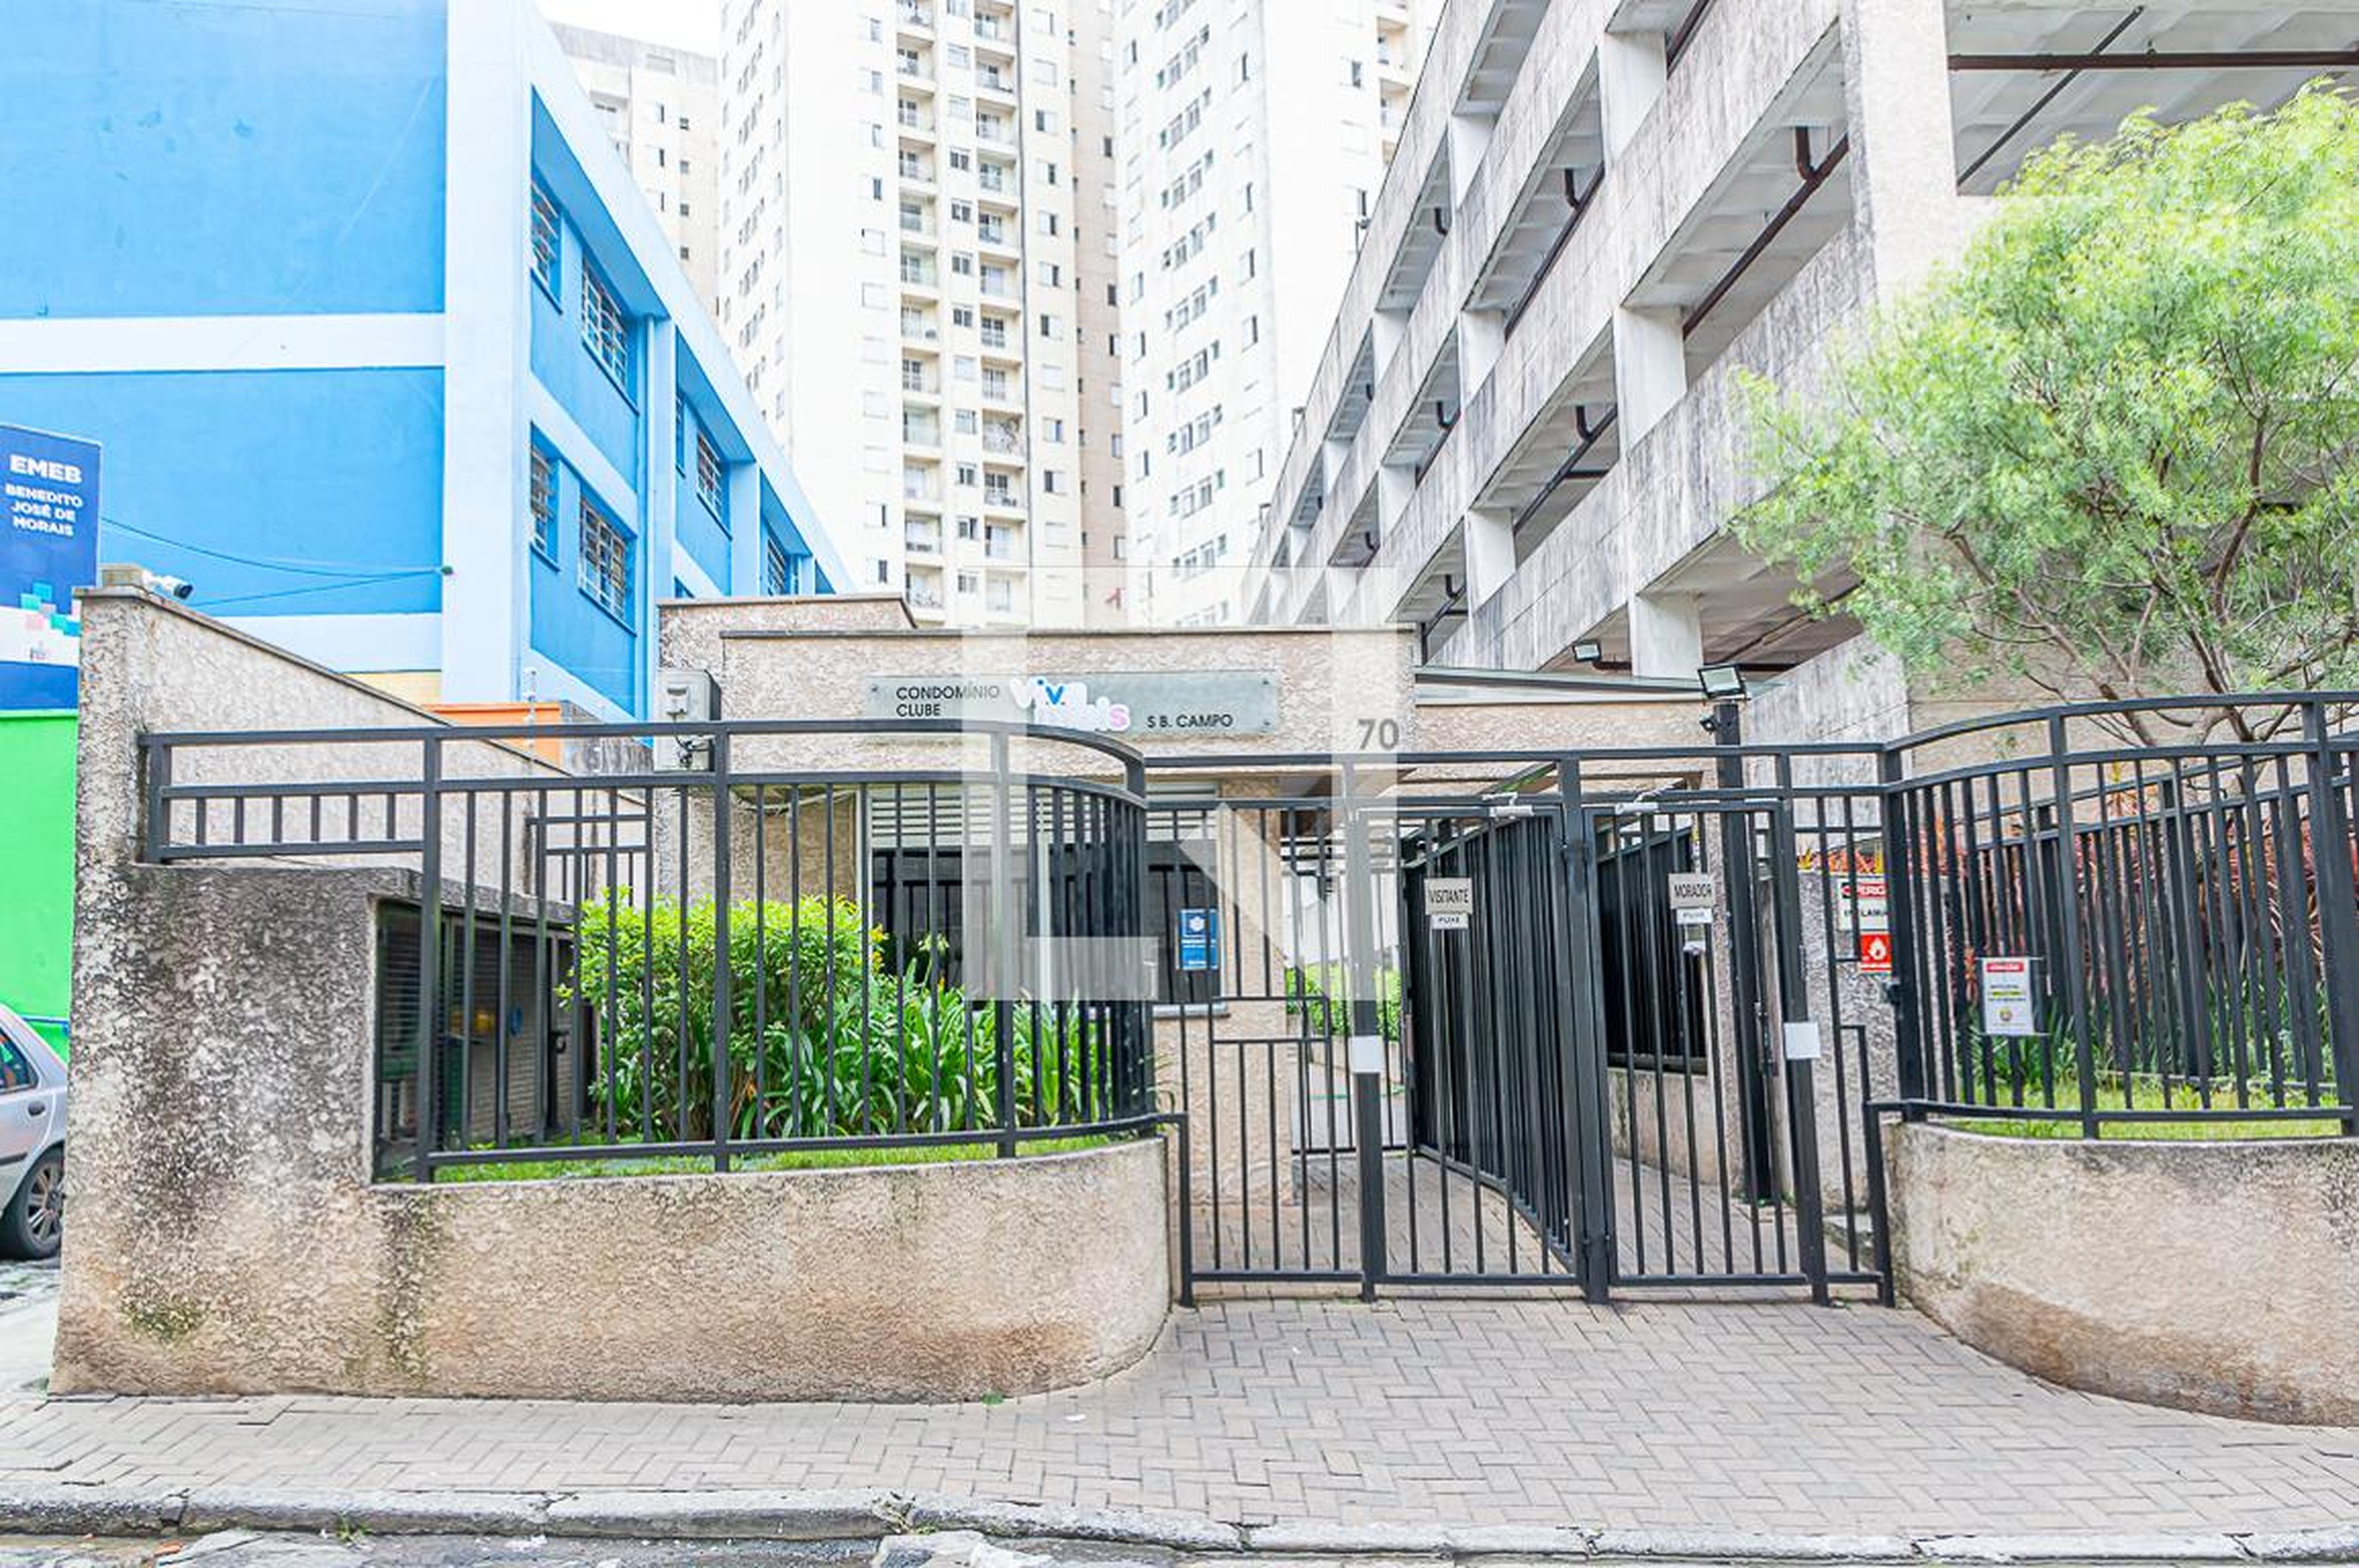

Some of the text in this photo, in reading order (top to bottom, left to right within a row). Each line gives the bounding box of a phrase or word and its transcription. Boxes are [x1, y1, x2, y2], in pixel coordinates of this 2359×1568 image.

[10, 454, 82, 483] EMEB
[5, 483, 83, 508] BENEDITO
[54, 507, 76, 523] DE
[12, 515, 74, 536] MORAIS
[896, 681, 1000, 700] CONDOMÍNIO
[896, 703, 942, 717] CLUBE
[1175, 714, 1234, 728] CAMPO
[1358, 719, 1399, 751] 70
[1428, 889, 1469, 904] VISITANTE
[1673, 883, 1712, 899] MORADOR
